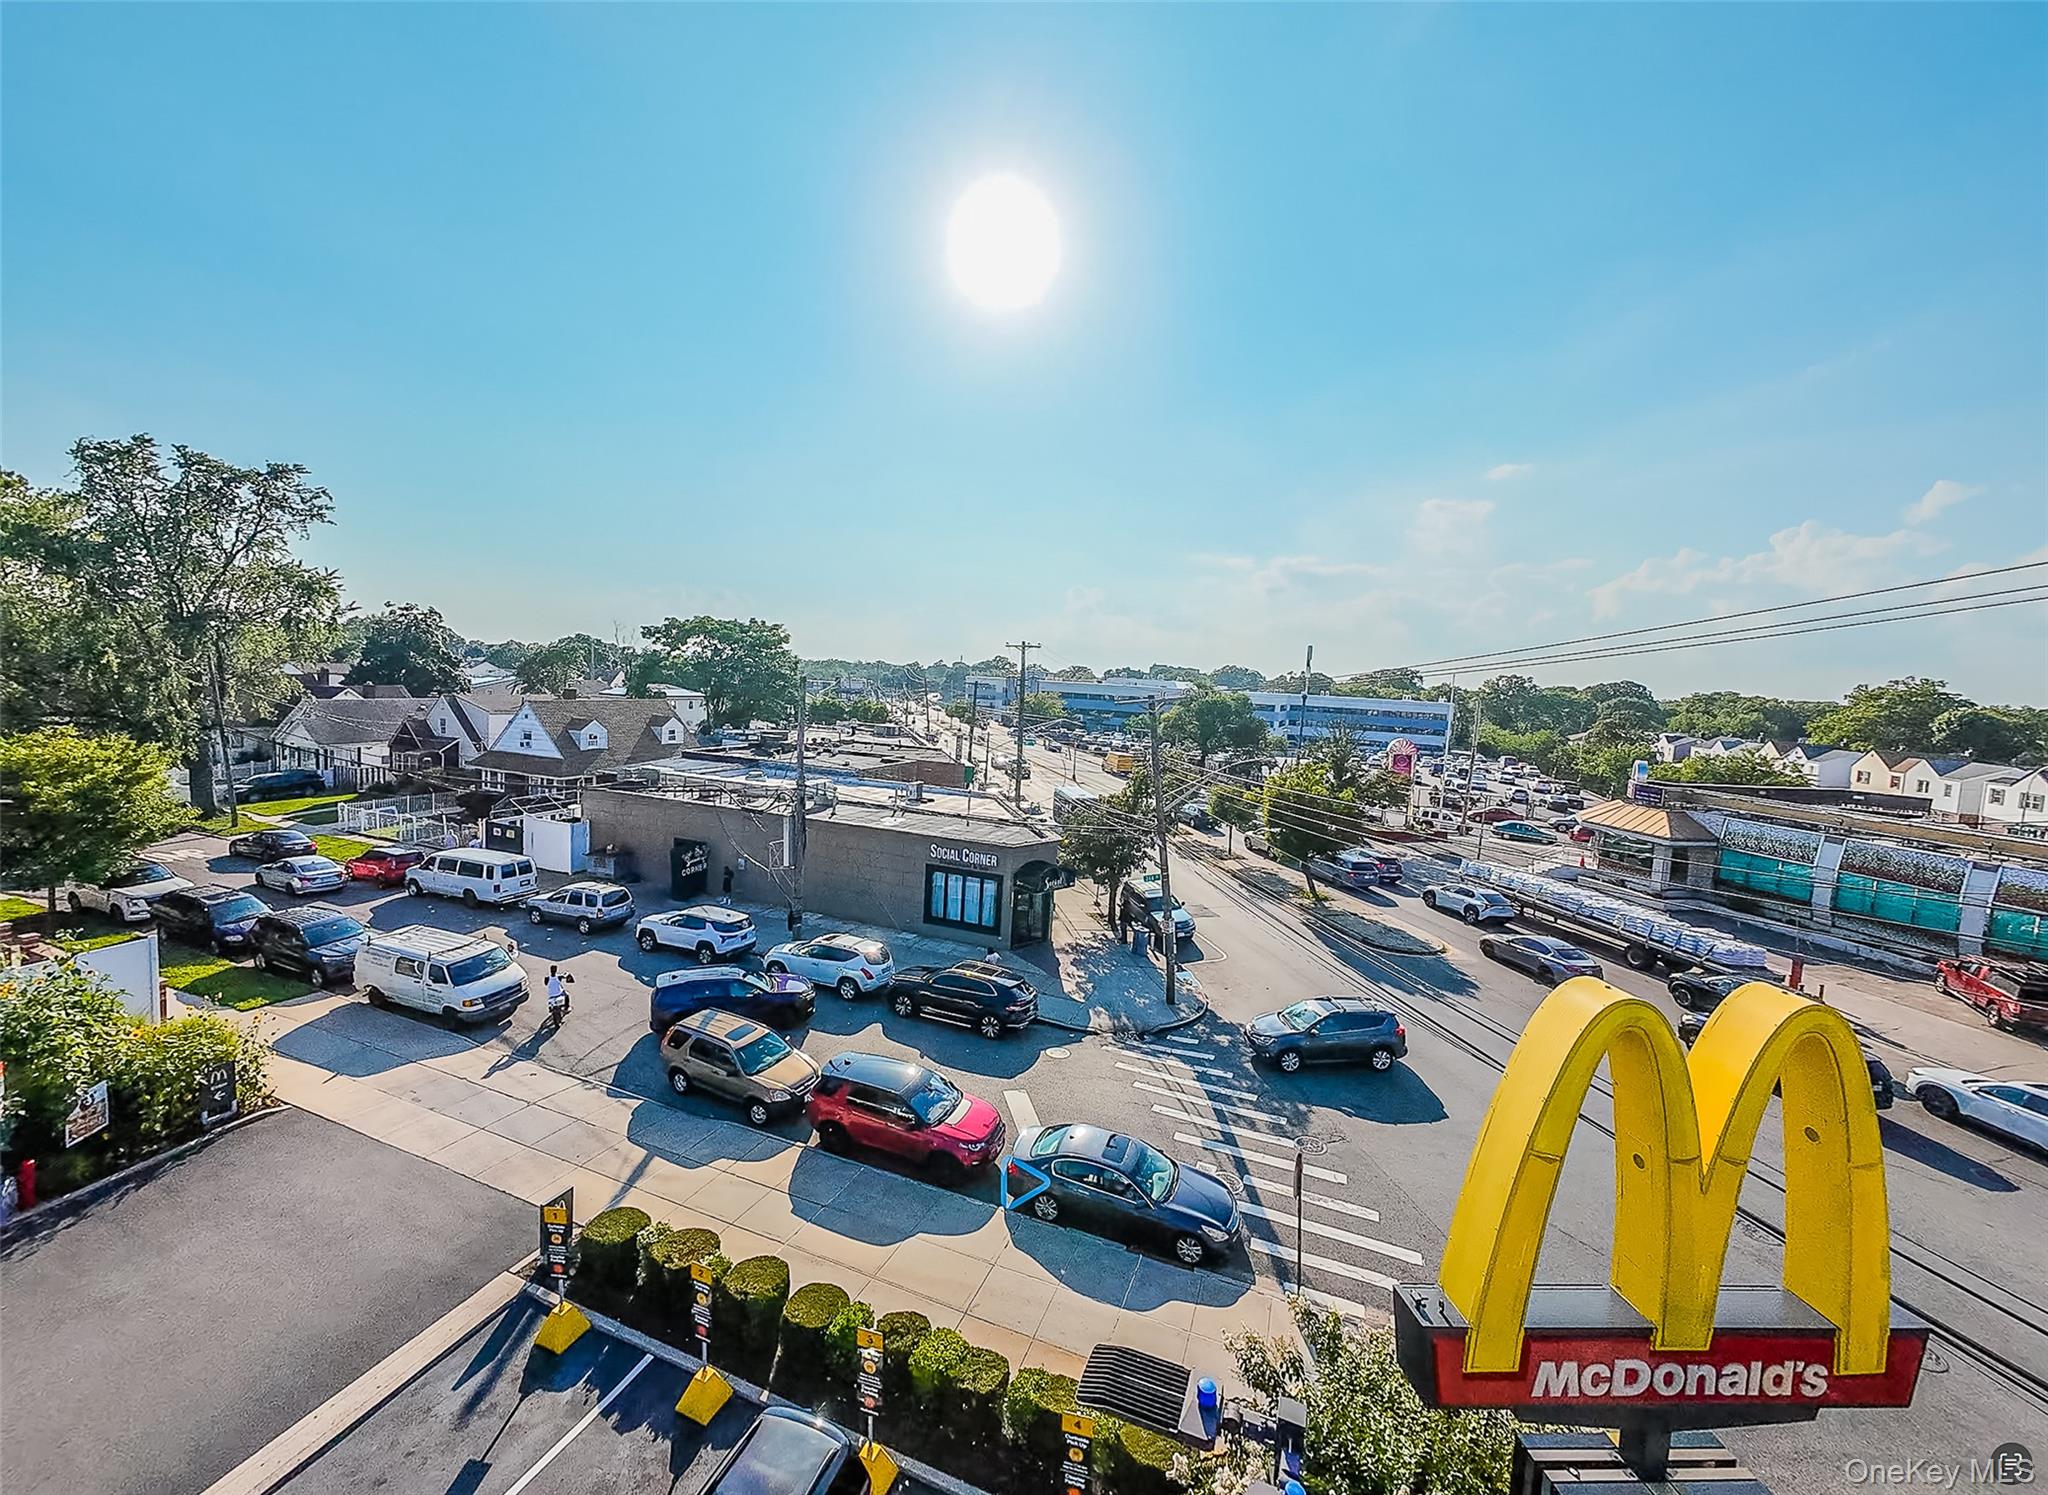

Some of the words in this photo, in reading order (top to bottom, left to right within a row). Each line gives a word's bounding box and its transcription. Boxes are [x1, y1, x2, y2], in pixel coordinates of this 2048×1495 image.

[930, 843, 961, 862] SOCIAL
[961, 848, 998, 867] CORNER
[681, 862, 707, 877] CORNER
[1530, 1357, 1829, 1398] McDonald's
[1073, 1419, 1082, 1430] 4
